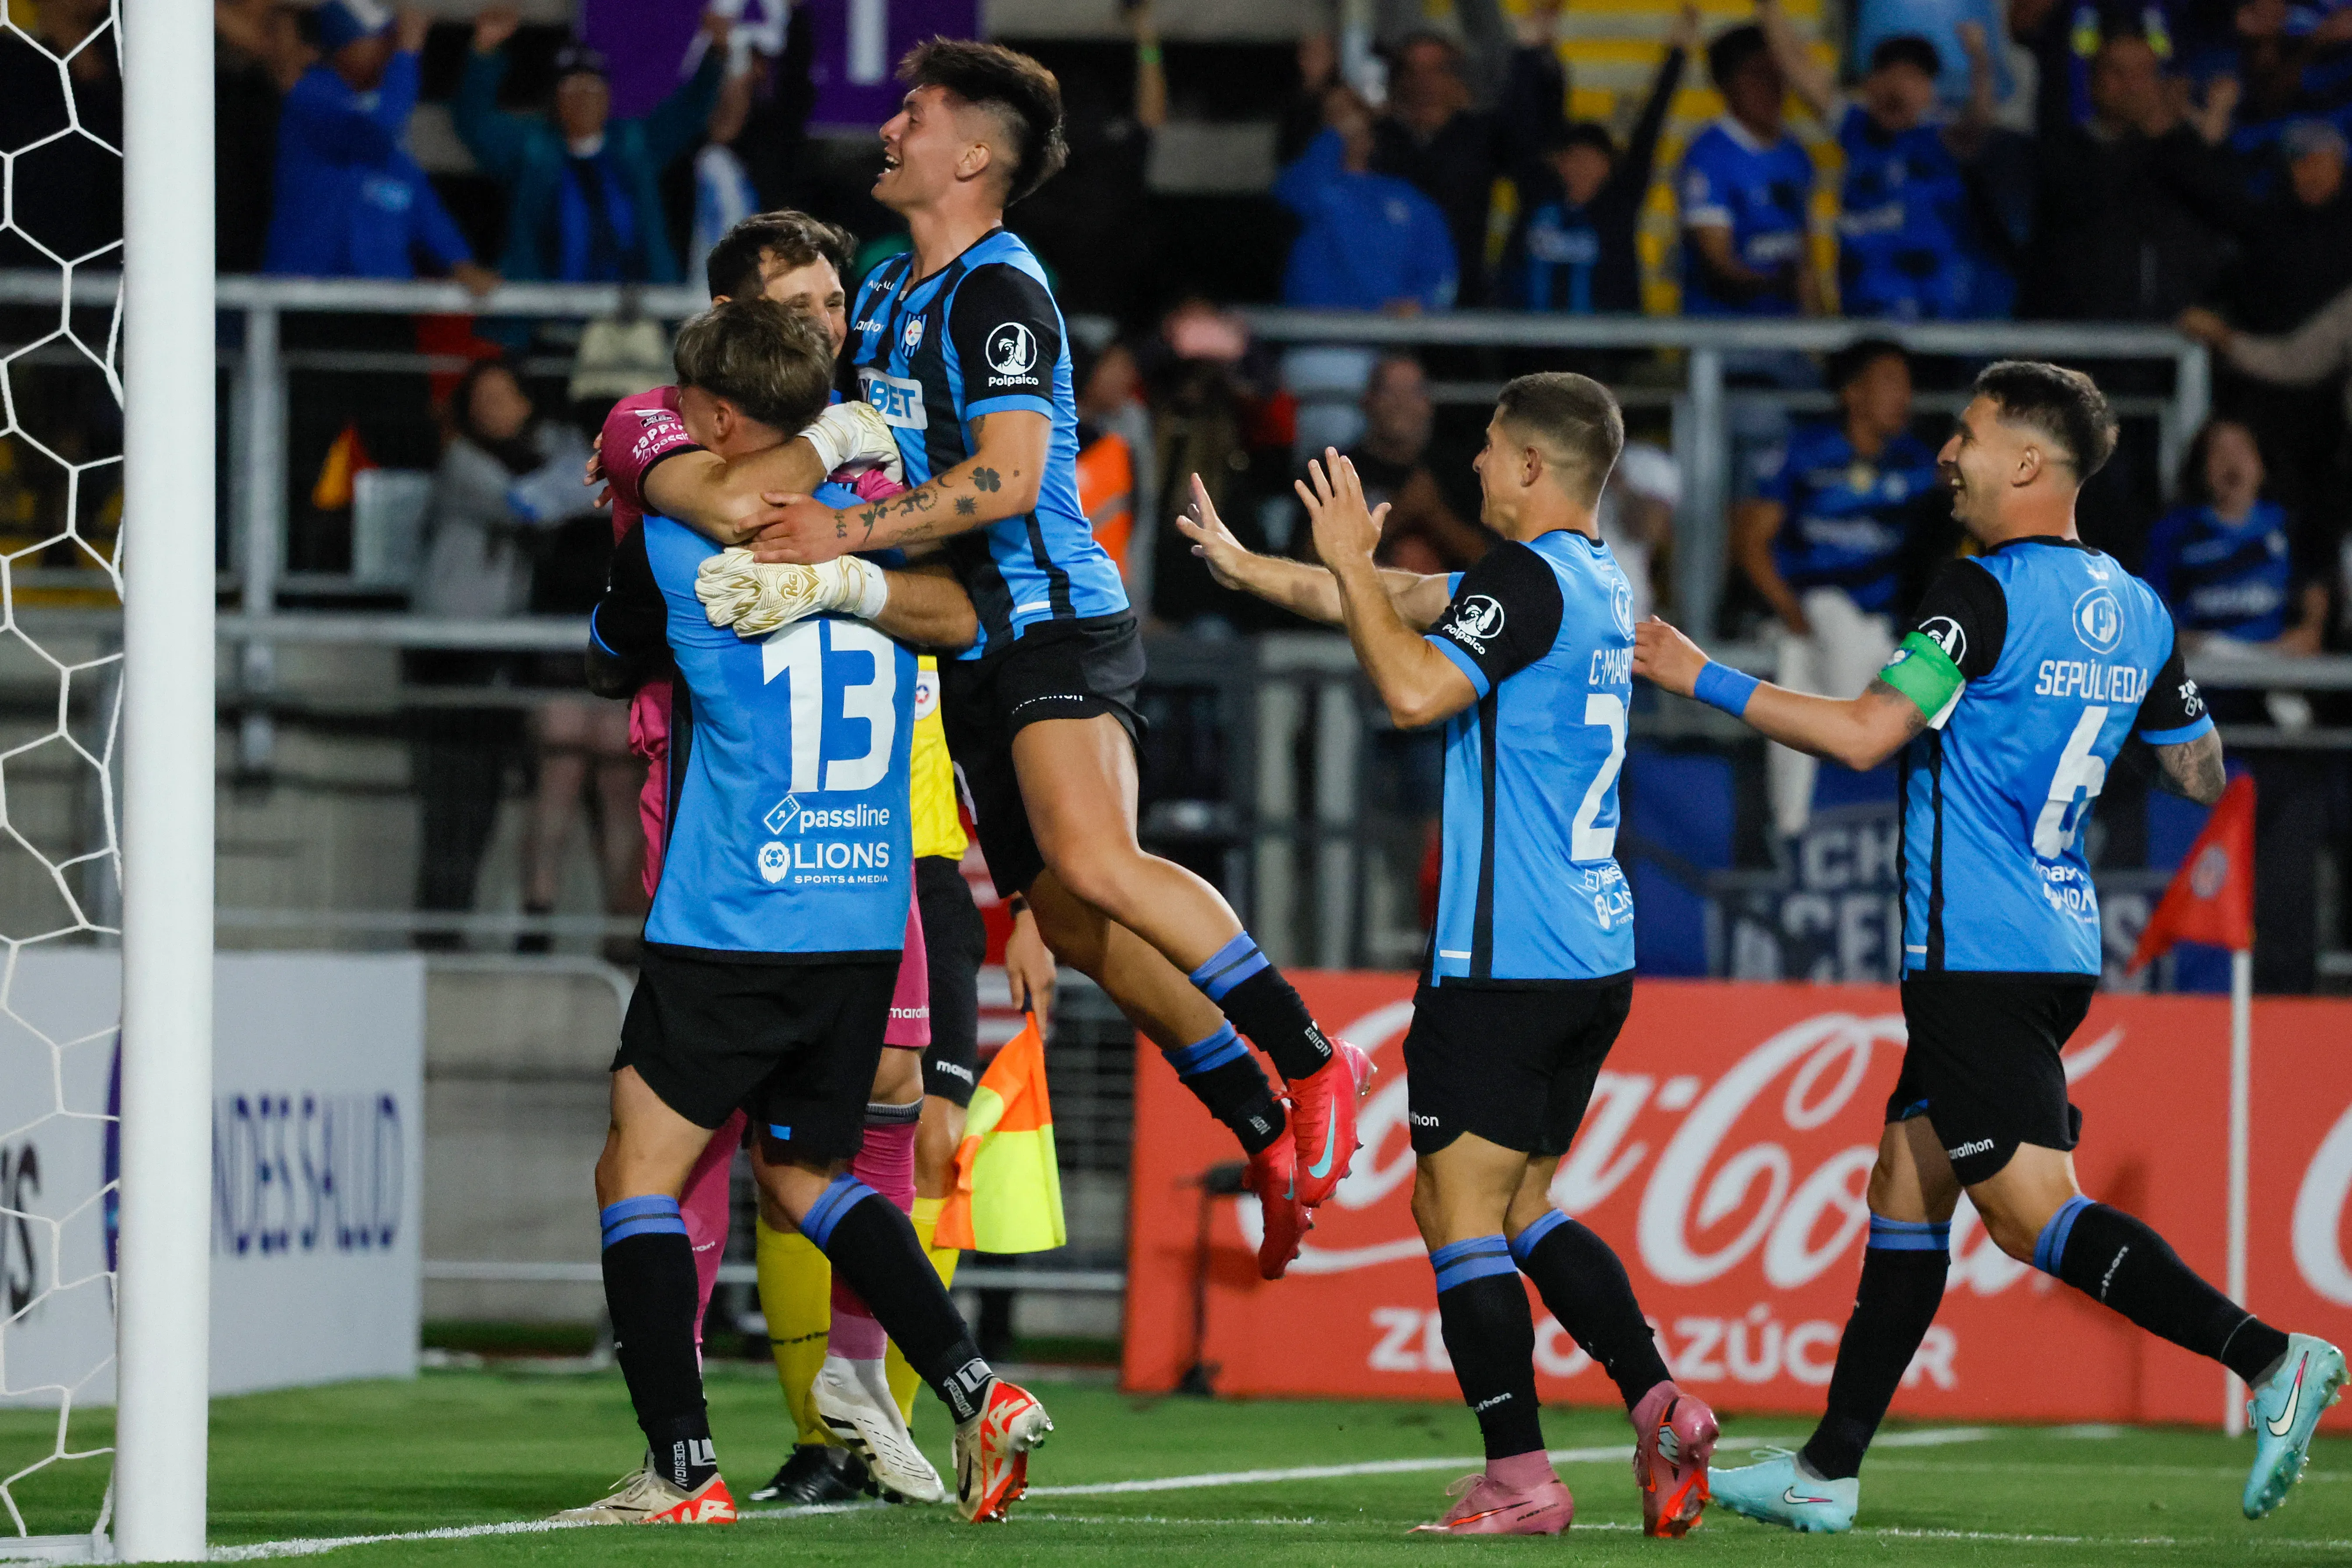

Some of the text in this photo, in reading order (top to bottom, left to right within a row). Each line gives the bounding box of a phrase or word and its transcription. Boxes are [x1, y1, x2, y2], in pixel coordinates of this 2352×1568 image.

[989, 373, 1039, 387] Polpaico
[1442, 623, 1485, 655] Polpaico
[762, 619, 896, 793] 13
[2031, 706, 2108, 860] 6
[799, 804, 890, 833] passline
[794, 843, 889, 869] LIONS
[1948, 1138, 1995, 1160] arathon
[1367, 1300, 1959, 1391] ZEO ZÚCR
